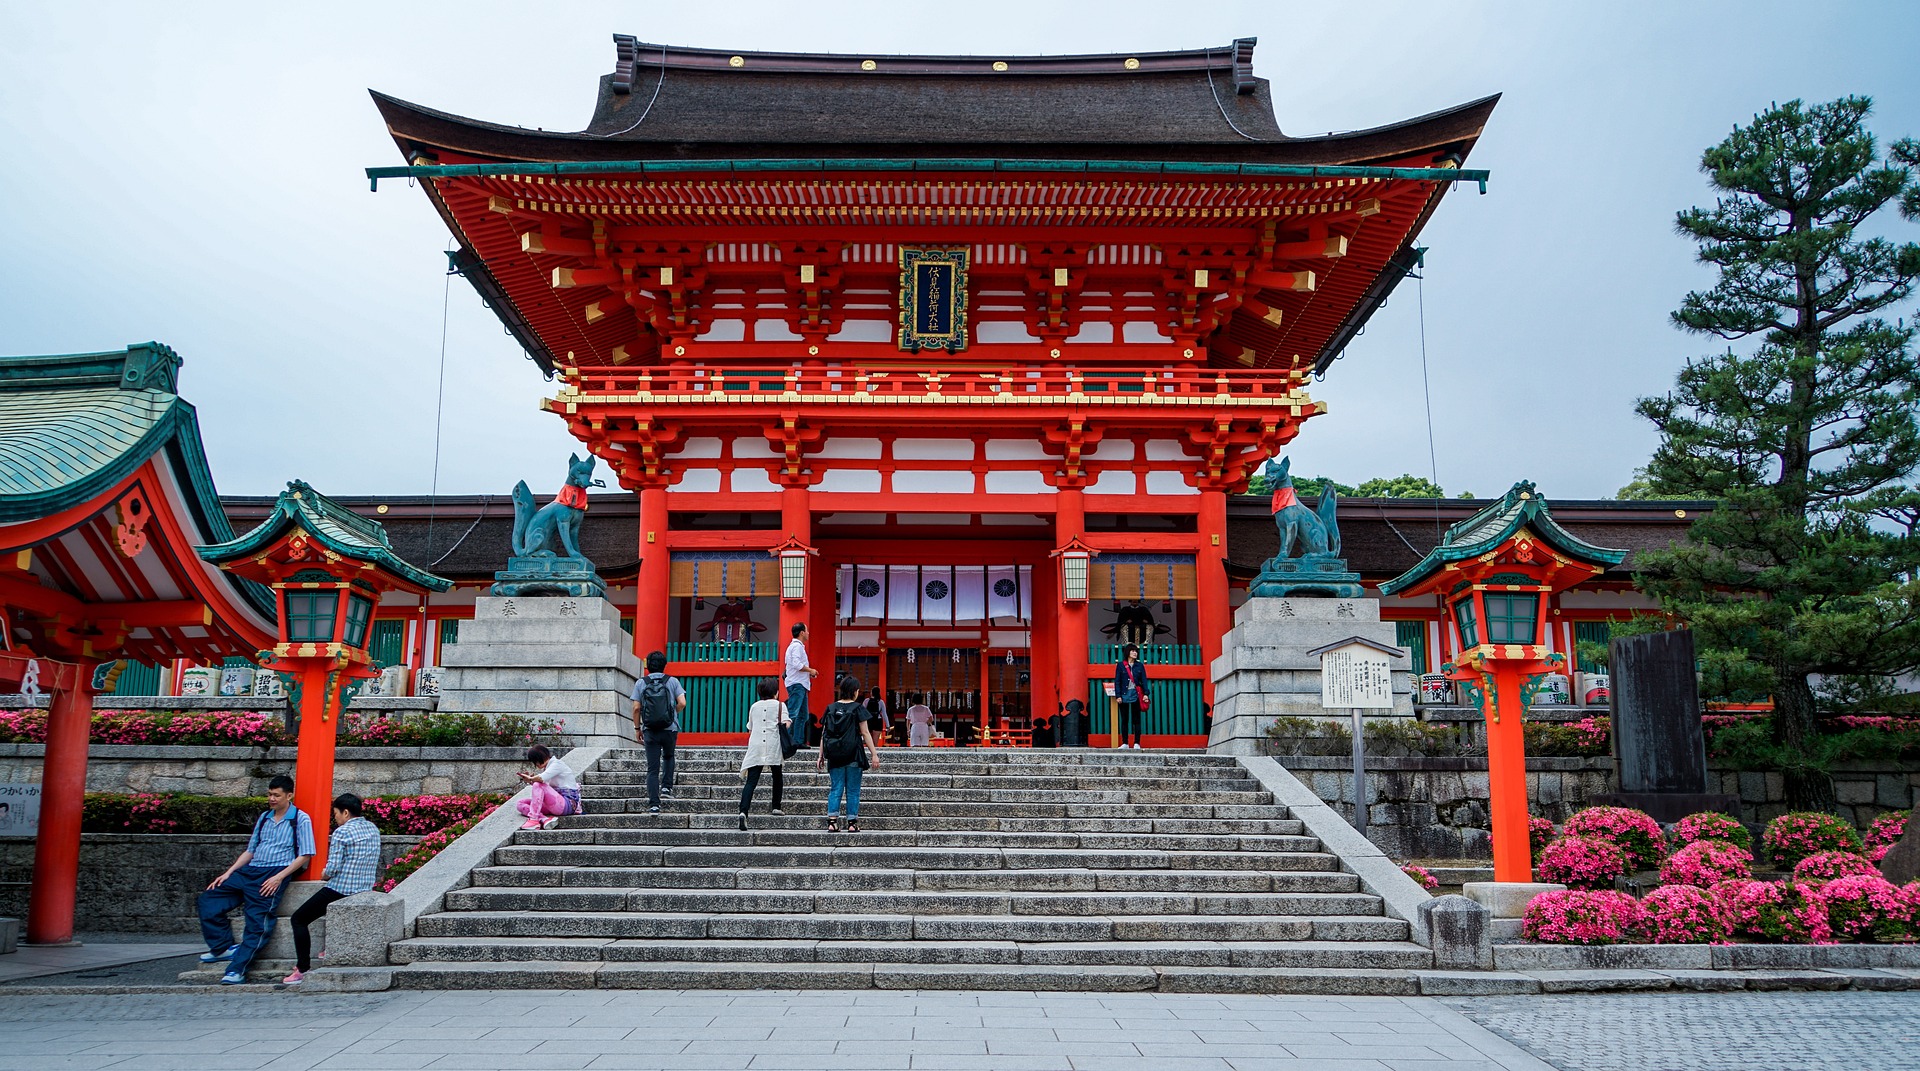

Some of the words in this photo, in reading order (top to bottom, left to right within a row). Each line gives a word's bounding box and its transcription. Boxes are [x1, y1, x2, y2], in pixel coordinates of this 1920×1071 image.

[928, 266, 941, 332] 伏見稲荷大社
